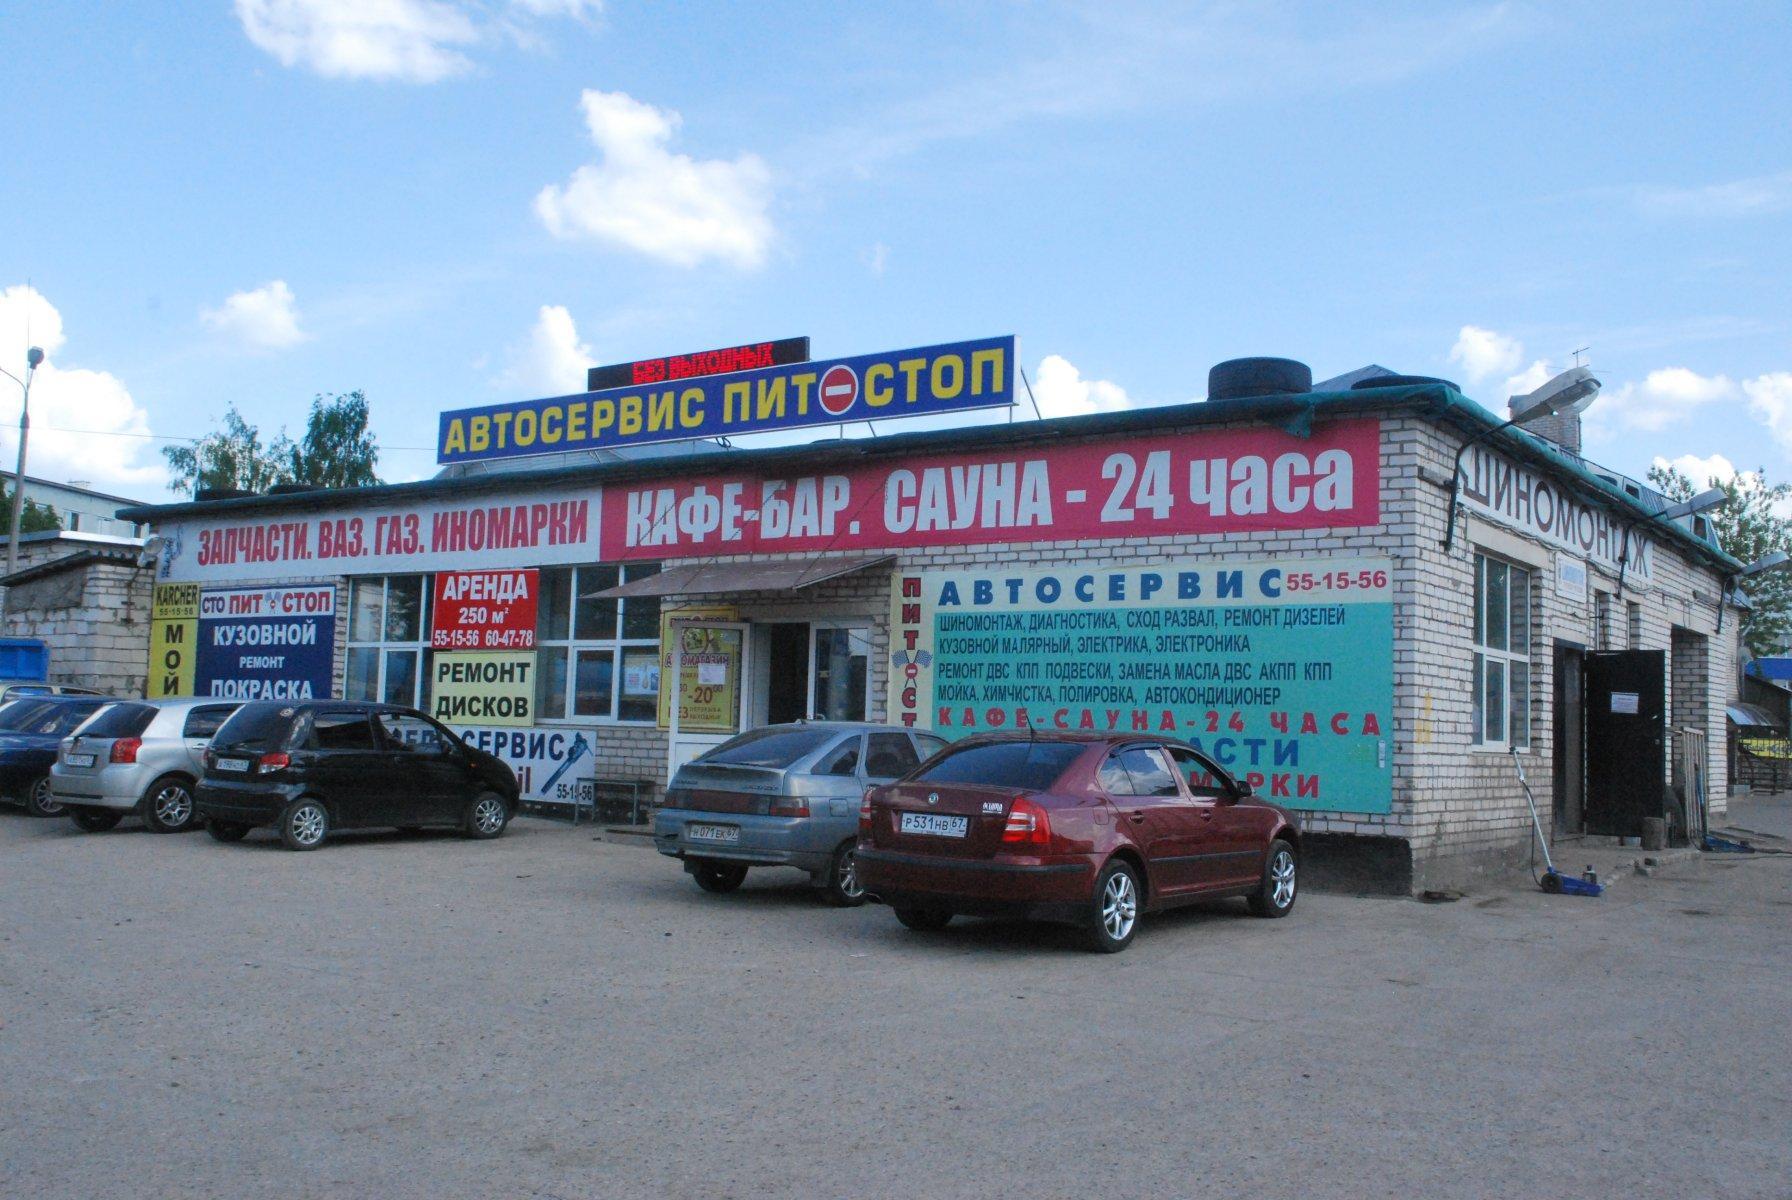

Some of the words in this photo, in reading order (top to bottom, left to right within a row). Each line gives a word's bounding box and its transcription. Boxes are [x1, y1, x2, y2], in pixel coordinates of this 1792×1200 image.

[632, 359, 666, 384] БЕЗ
[668, 342, 774, 380] ВЫХОДНЫХ
[444, 387, 705, 454] АВТОСЕРВИС
[723, 373, 817, 424] ПИТ
[864, 347, 1004, 407] СТОП
[626, 475, 860, 547] КАФЕ-БАР.
[884, 460, 1054, 534] САУНА
[1100, 450, 1174, 523] 24
[1458, 446, 1648, 578] ШИНОМОНТАЖ
[197, 522, 312, 566] ЗАПЧАСТИ.
[317, 517, 368, 559] ВАЗ.
[374, 513, 424, 557] ГАЗ.
[431, 500, 588, 552] ИНОМАРКИ
[155, 584, 198, 606] KARCHER
[442, 574, 528, 604] АРЕНДА
[938, 568, 1281, 606] АВТОСЕРВИС
[1286, 570, 1387, 591] 55-15-56
[202, 596, 226, 614] СТО
[229, 594, 264, 614] ПИТ
[282, 591, 331, 613] СТОП
[458, 607, 487, 624] 250
[1028, 612, 1120, 632] ДИАГНОСТИКА,
[1126, 610, 1160, 630] СХОД
[1164, 609, 1218, 629] РАЗВАЛ,
[1224, 608, 1280, 627] РЕМОНТ
[1283, 604, 1345, 629] ДИЗЕЛЕЙ
[213, 619, 317, 646] КУЗОВНОЙ
[434, 629, 479, 646] 55-15-56
[485, 629, 533, 646] 60-47-78
[939, 634, 998, 654] КУЗОВНОЙ
[1002, 633, 1074, 656] МАЛЯРНЫЙ,
[1077, 635, 1152, 655] ЭЛЕКТРИКА,
[1155, 634, 1251, 653] ЭЛЕКТРОНИКА
[239, 656, 285, 669] РЕМОНТ
[438, 662, 531, 683] РЕМОНТ
[938, 663, 984, 679] РЕМОНТ
[986, 663, 1010, 682] ДВС
[1016, 663, 1039, 679] КПП
[1045, 662, 1114, 682] ПОДВЕСКИ,
[1118, 663, 1171, 680] ЗАМЕНА
[1174, 662, 1220, 680] МАСЛА
[1224, 662, 1251, 683] ДВС
[1259, 662, 1296, 680] АКПП
[1304, 662, 1332, 680] КПП
[211, 679, 313, 700] ПОКРАСКА
[983, 685, 1055, 705] ХИМЧИСТКА,
[1059, 686, 1137, 706] ПОЛИРОВКА,
[1144, 686, 1281, 707] АВТОКОНДИЦИОНЕР
[436, 696, 529, 720] ДИСКОВ
[1270, 711, 1382, 737] ЧАСА
